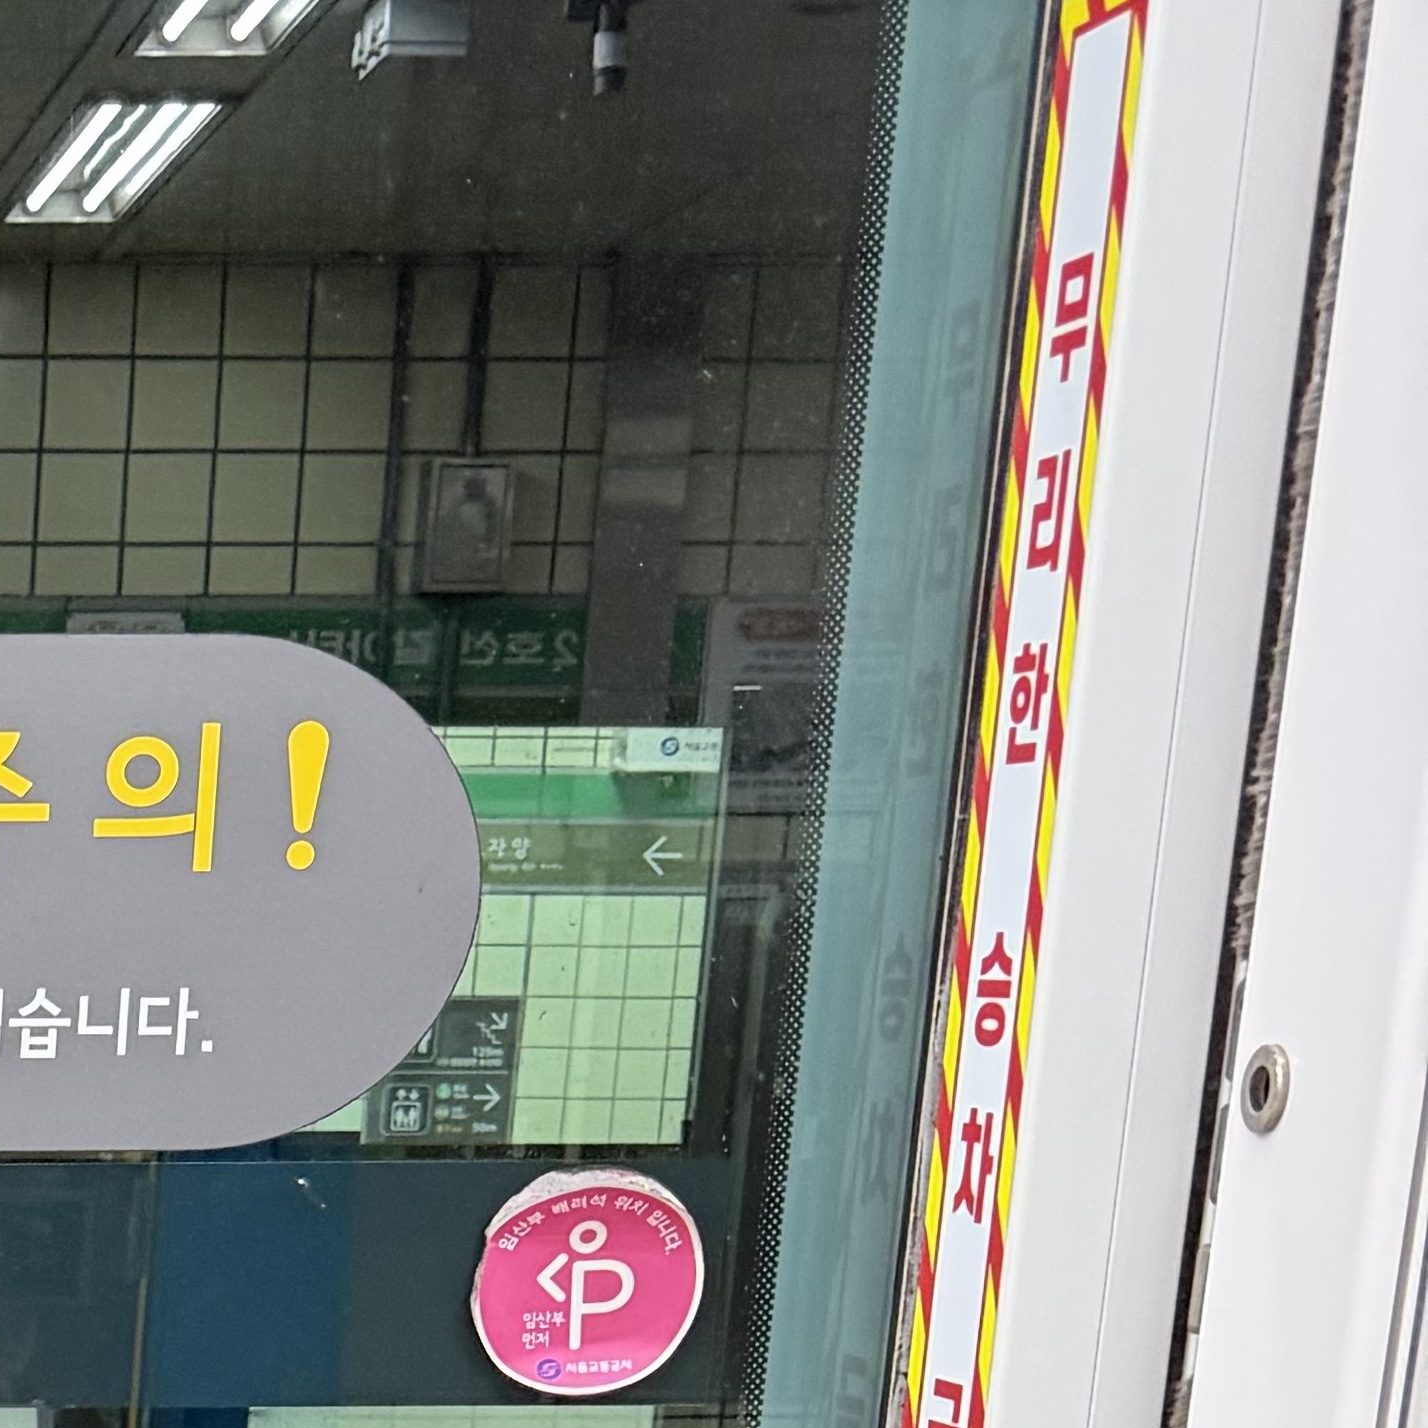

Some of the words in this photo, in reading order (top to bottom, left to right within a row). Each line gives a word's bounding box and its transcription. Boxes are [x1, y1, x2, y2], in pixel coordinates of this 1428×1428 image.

[1006, 252, 1094, 766] 무리한
[952, 932, 1013, 1223] 승차
[498, 1211, 546, 1252] 임산부
[521, 1330, 550, 1350] 먼저
[522, 1310, 567, 1330] 임산부
